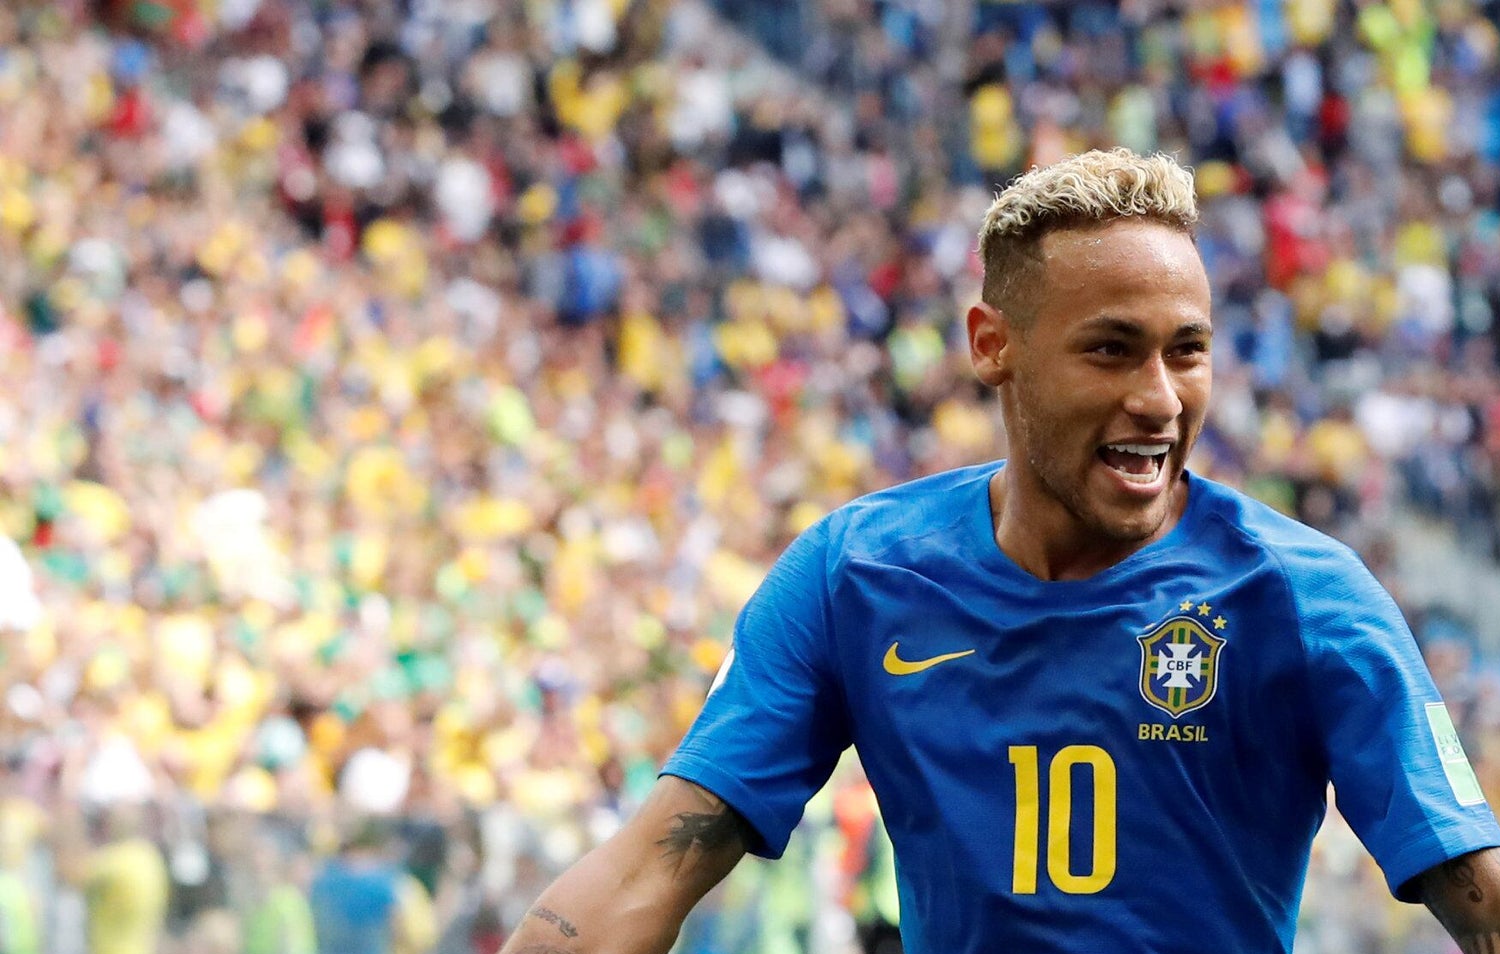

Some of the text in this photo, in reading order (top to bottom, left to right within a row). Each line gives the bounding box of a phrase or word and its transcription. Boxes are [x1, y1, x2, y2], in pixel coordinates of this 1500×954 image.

[1166, 660, 1193, 672] CBF
[1138, 723, 1209, 742] BRASIL
[1008, 744, 1117, 894] 10
